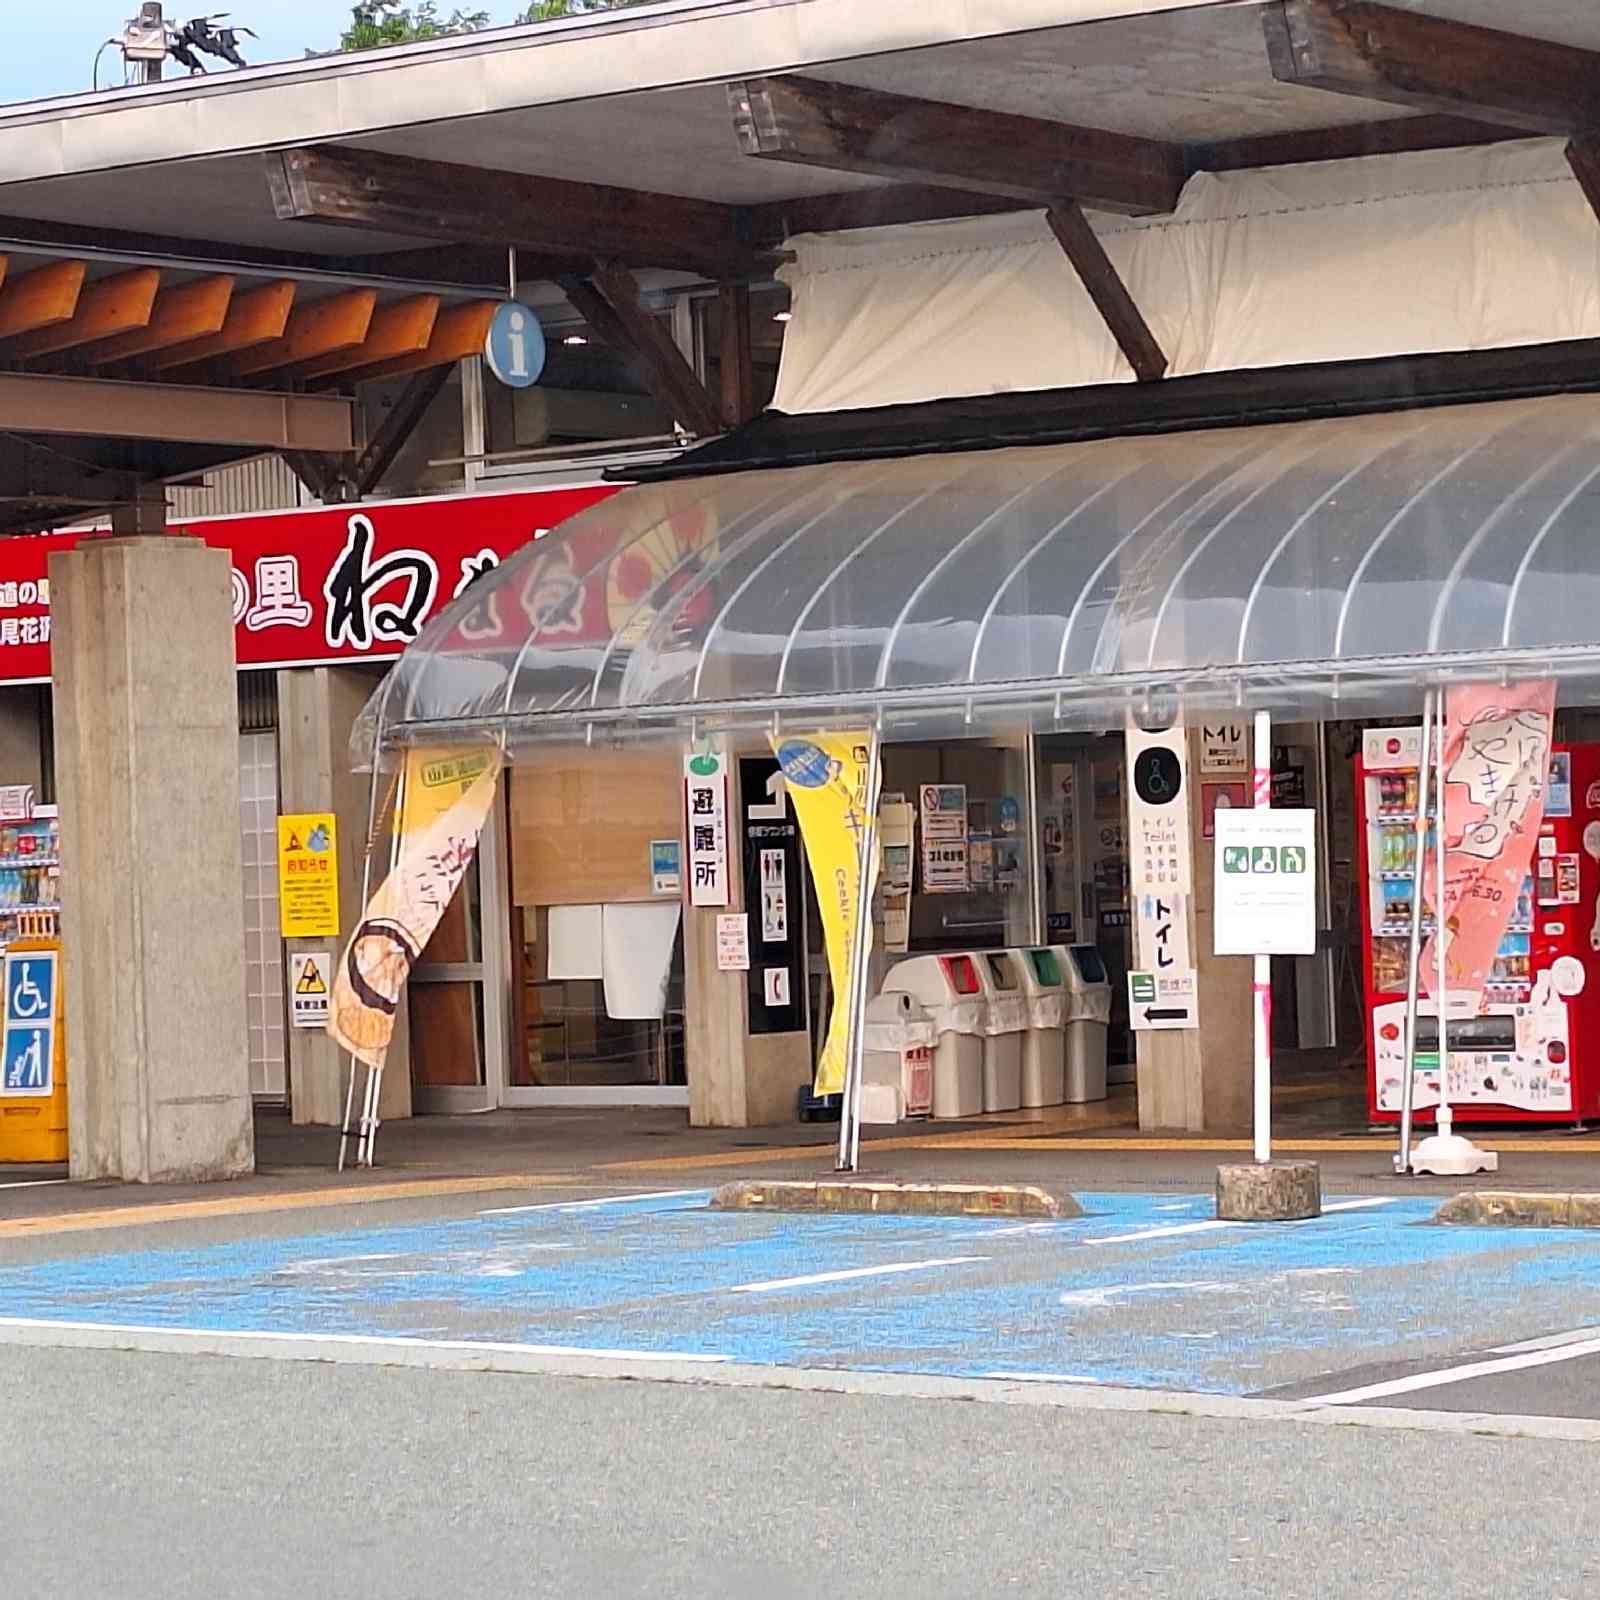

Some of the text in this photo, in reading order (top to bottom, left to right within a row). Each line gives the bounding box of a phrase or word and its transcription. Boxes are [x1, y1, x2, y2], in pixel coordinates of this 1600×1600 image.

[507, 311, 529, 377] i
[1203, 725, 1241, 744] トイレ
[1142, 816, 1176, 828] トイレ
[1155, 898, 1174, 968] トイレ
